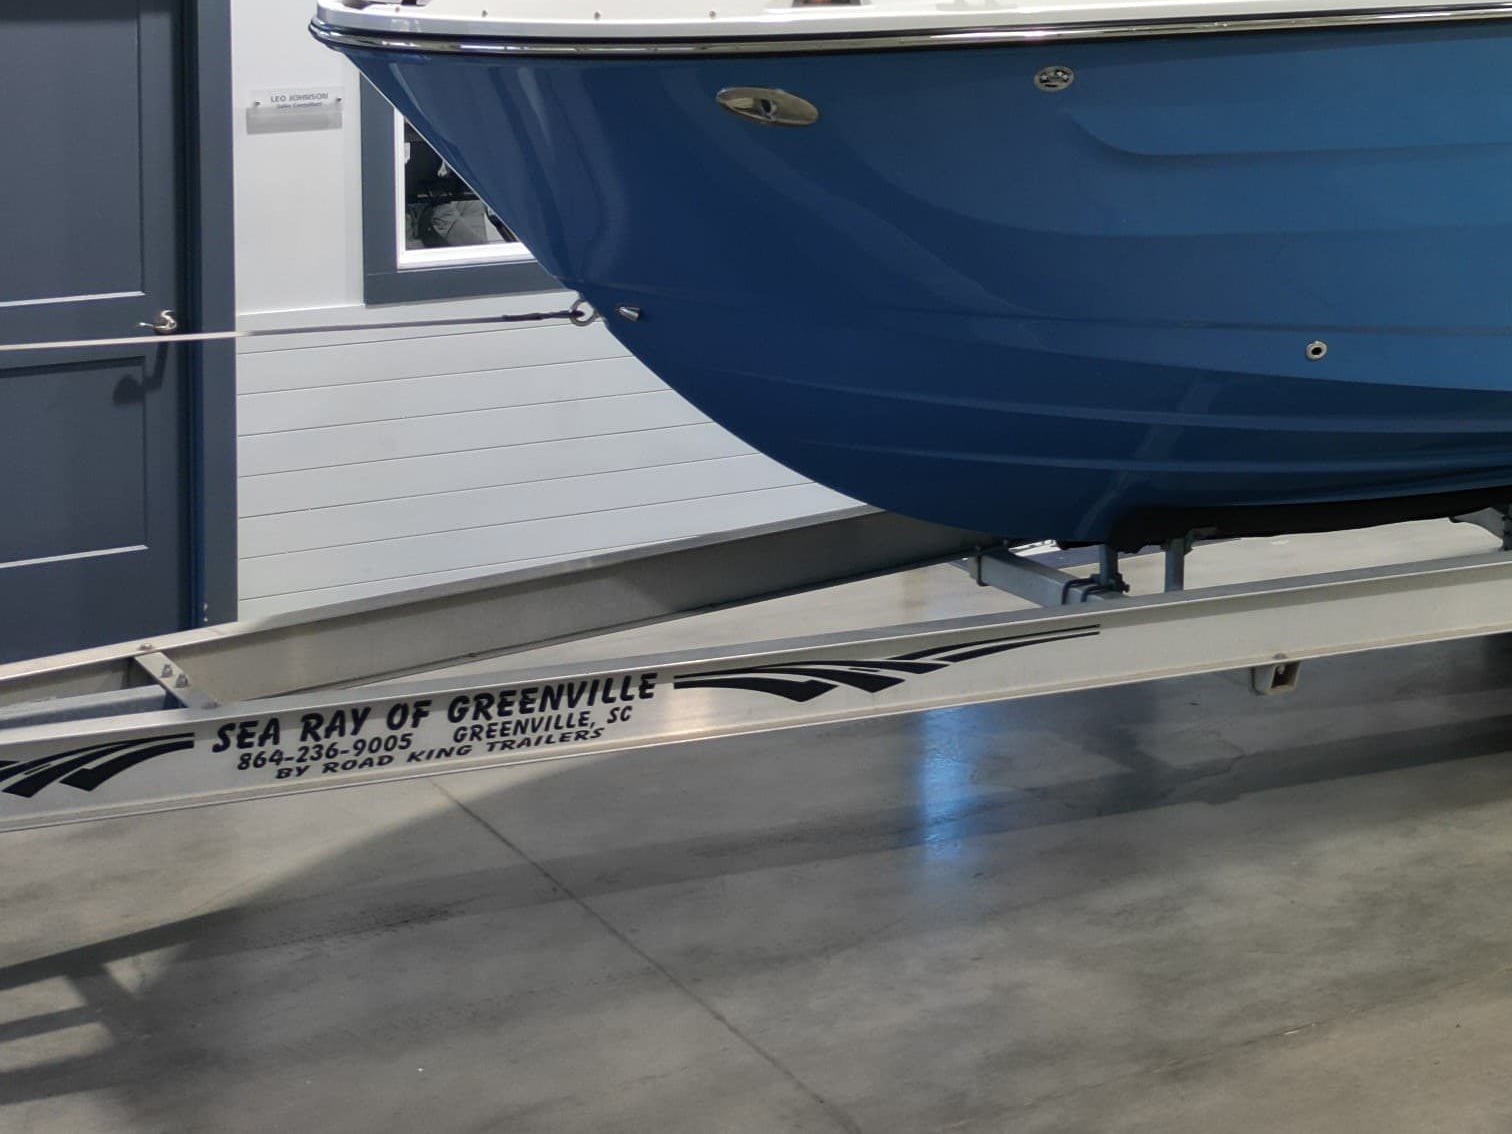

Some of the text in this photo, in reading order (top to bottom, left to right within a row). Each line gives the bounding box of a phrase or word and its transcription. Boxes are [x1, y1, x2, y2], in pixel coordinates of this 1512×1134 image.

[270, 94, 286, 103] LEO
[212, 672, 658, 754] SEA RAY OF GREENVILLE
[237, 705, 633, 771] 864-236-9005 GREENVILLE, SC
[275, 727, 605, 780] BY ROAD KING TRAILERS
